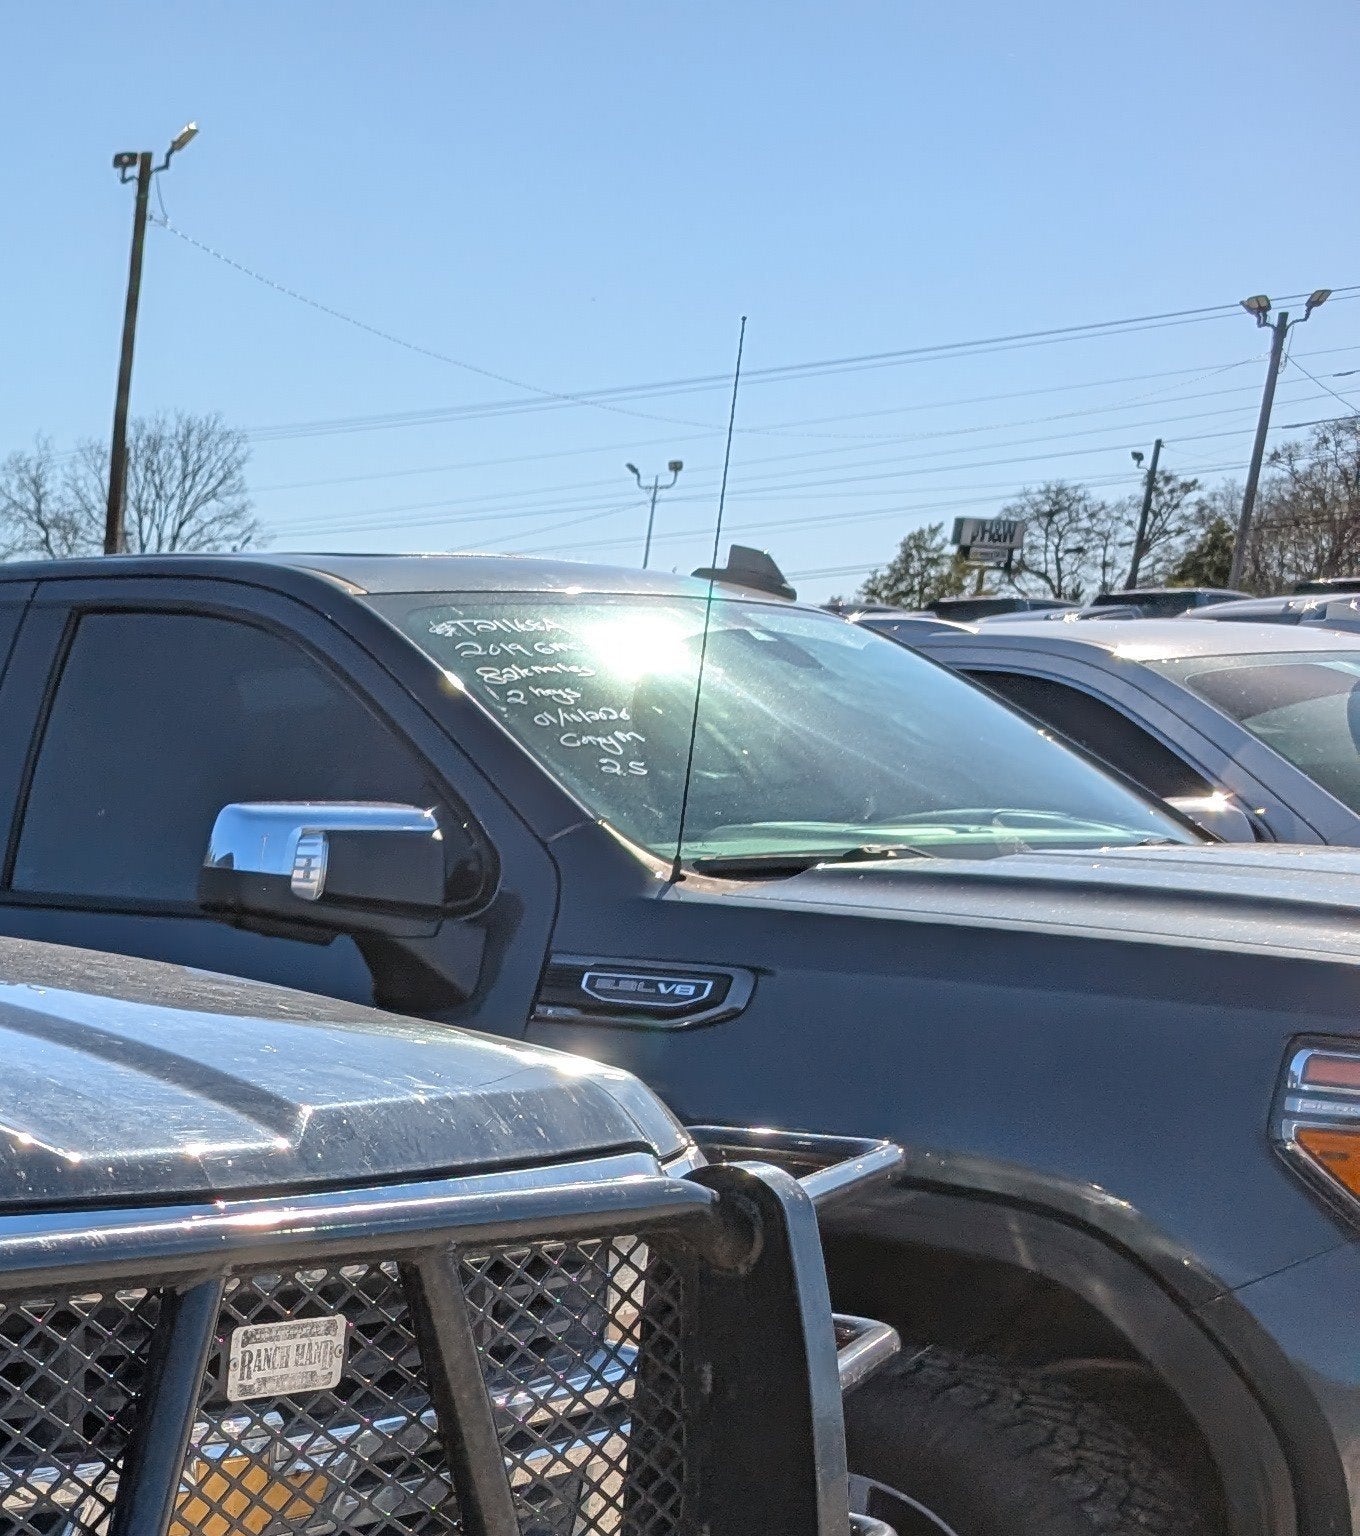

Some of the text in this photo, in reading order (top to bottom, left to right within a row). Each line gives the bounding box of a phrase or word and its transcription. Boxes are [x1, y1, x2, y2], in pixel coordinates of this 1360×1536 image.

[454, 641, 534, 659] 2019
[657, 982, 696, 996] V8
[238, 1344, 291, 1382] RANCH
